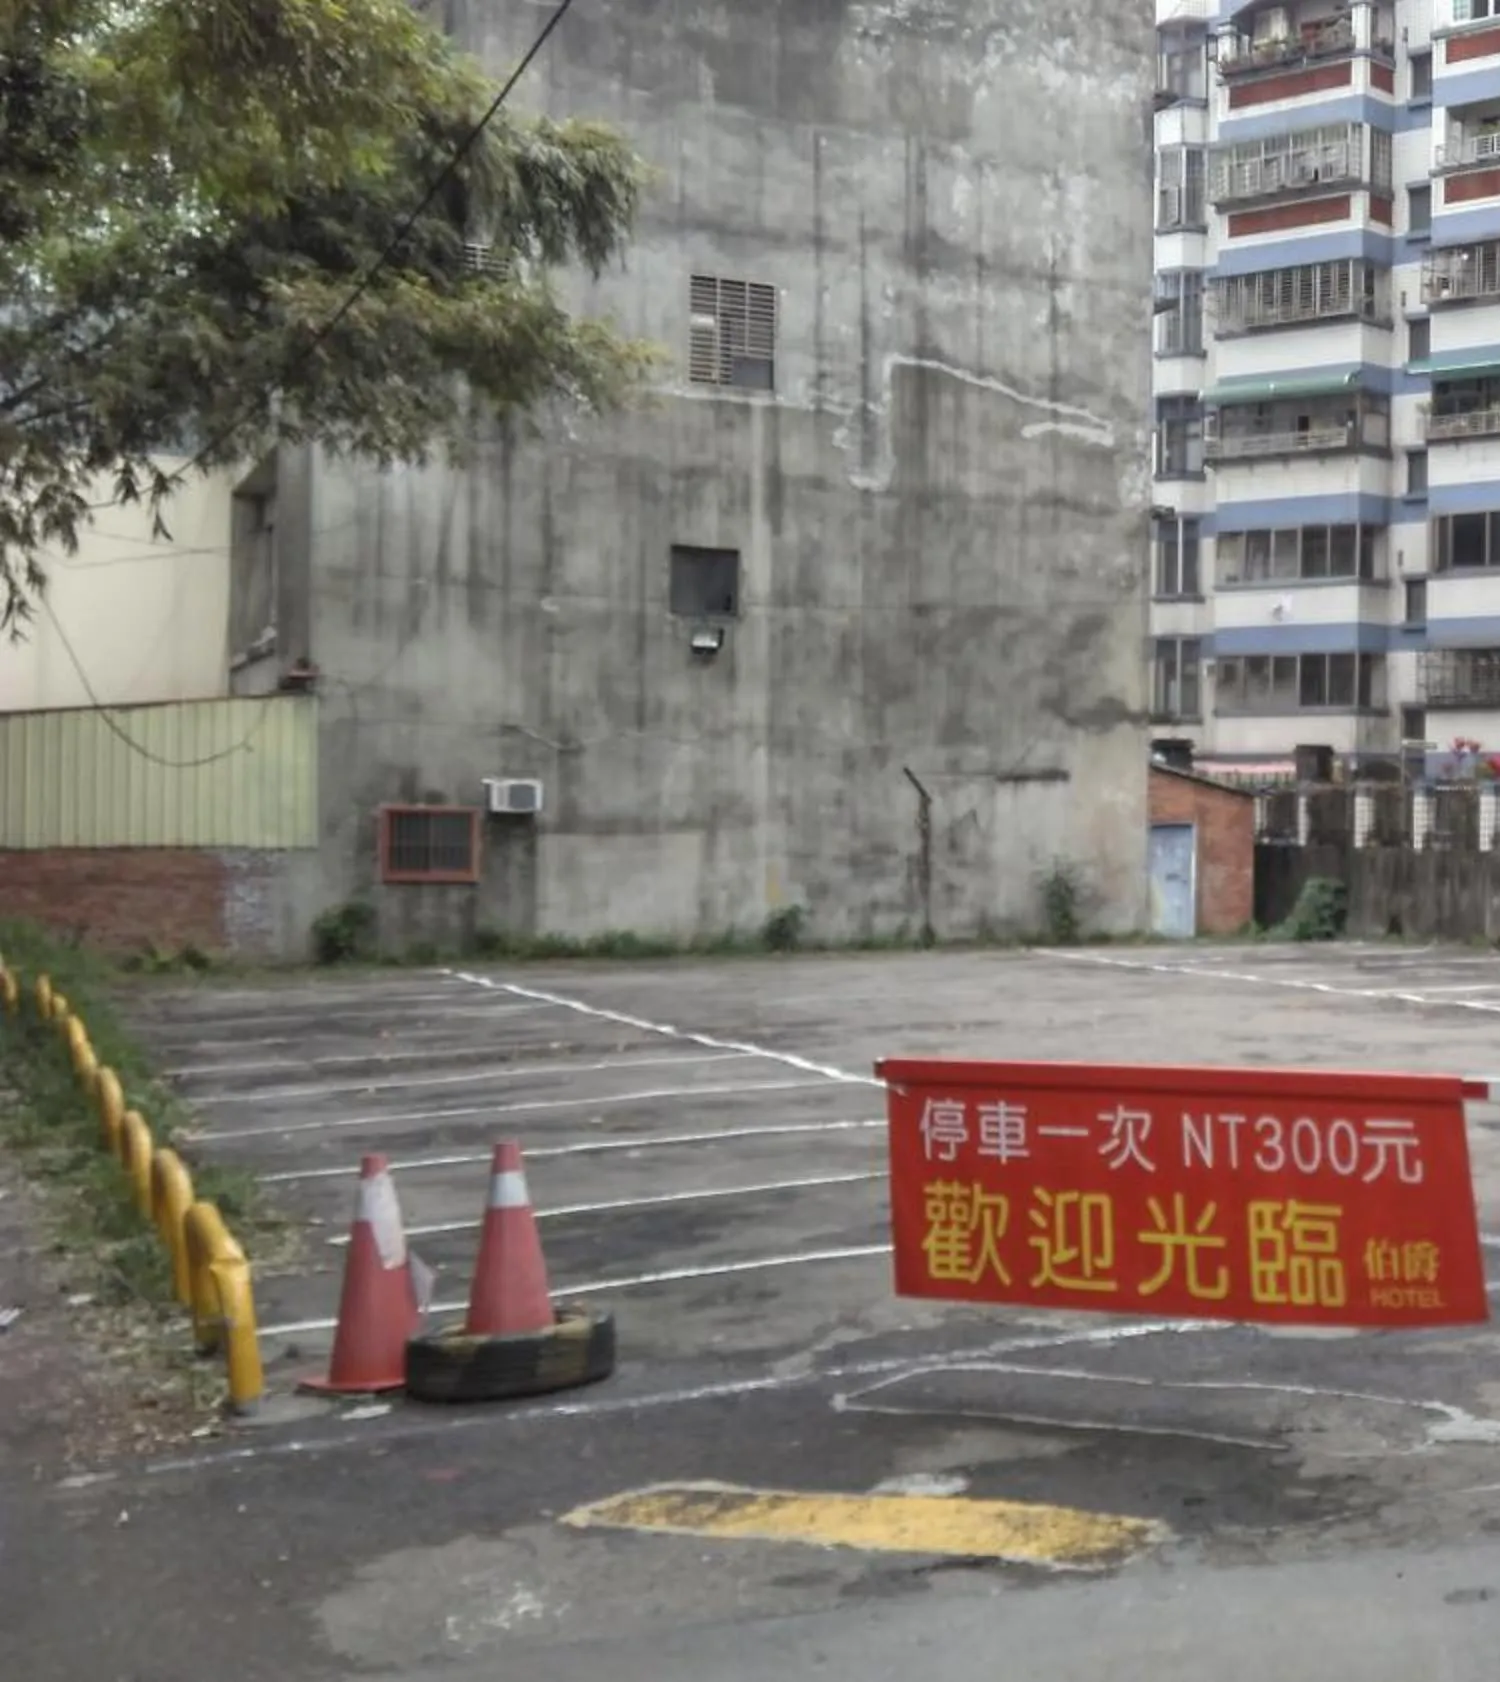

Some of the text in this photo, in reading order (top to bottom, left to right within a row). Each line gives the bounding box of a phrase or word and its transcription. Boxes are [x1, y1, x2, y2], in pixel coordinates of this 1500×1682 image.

[919, 1097, 1425, 1184] 停車一次 NT300元
[920, 1180, 1346, 1307] 歡迎光臨
[1370, 1287, 1449, 1309] HOTEL
